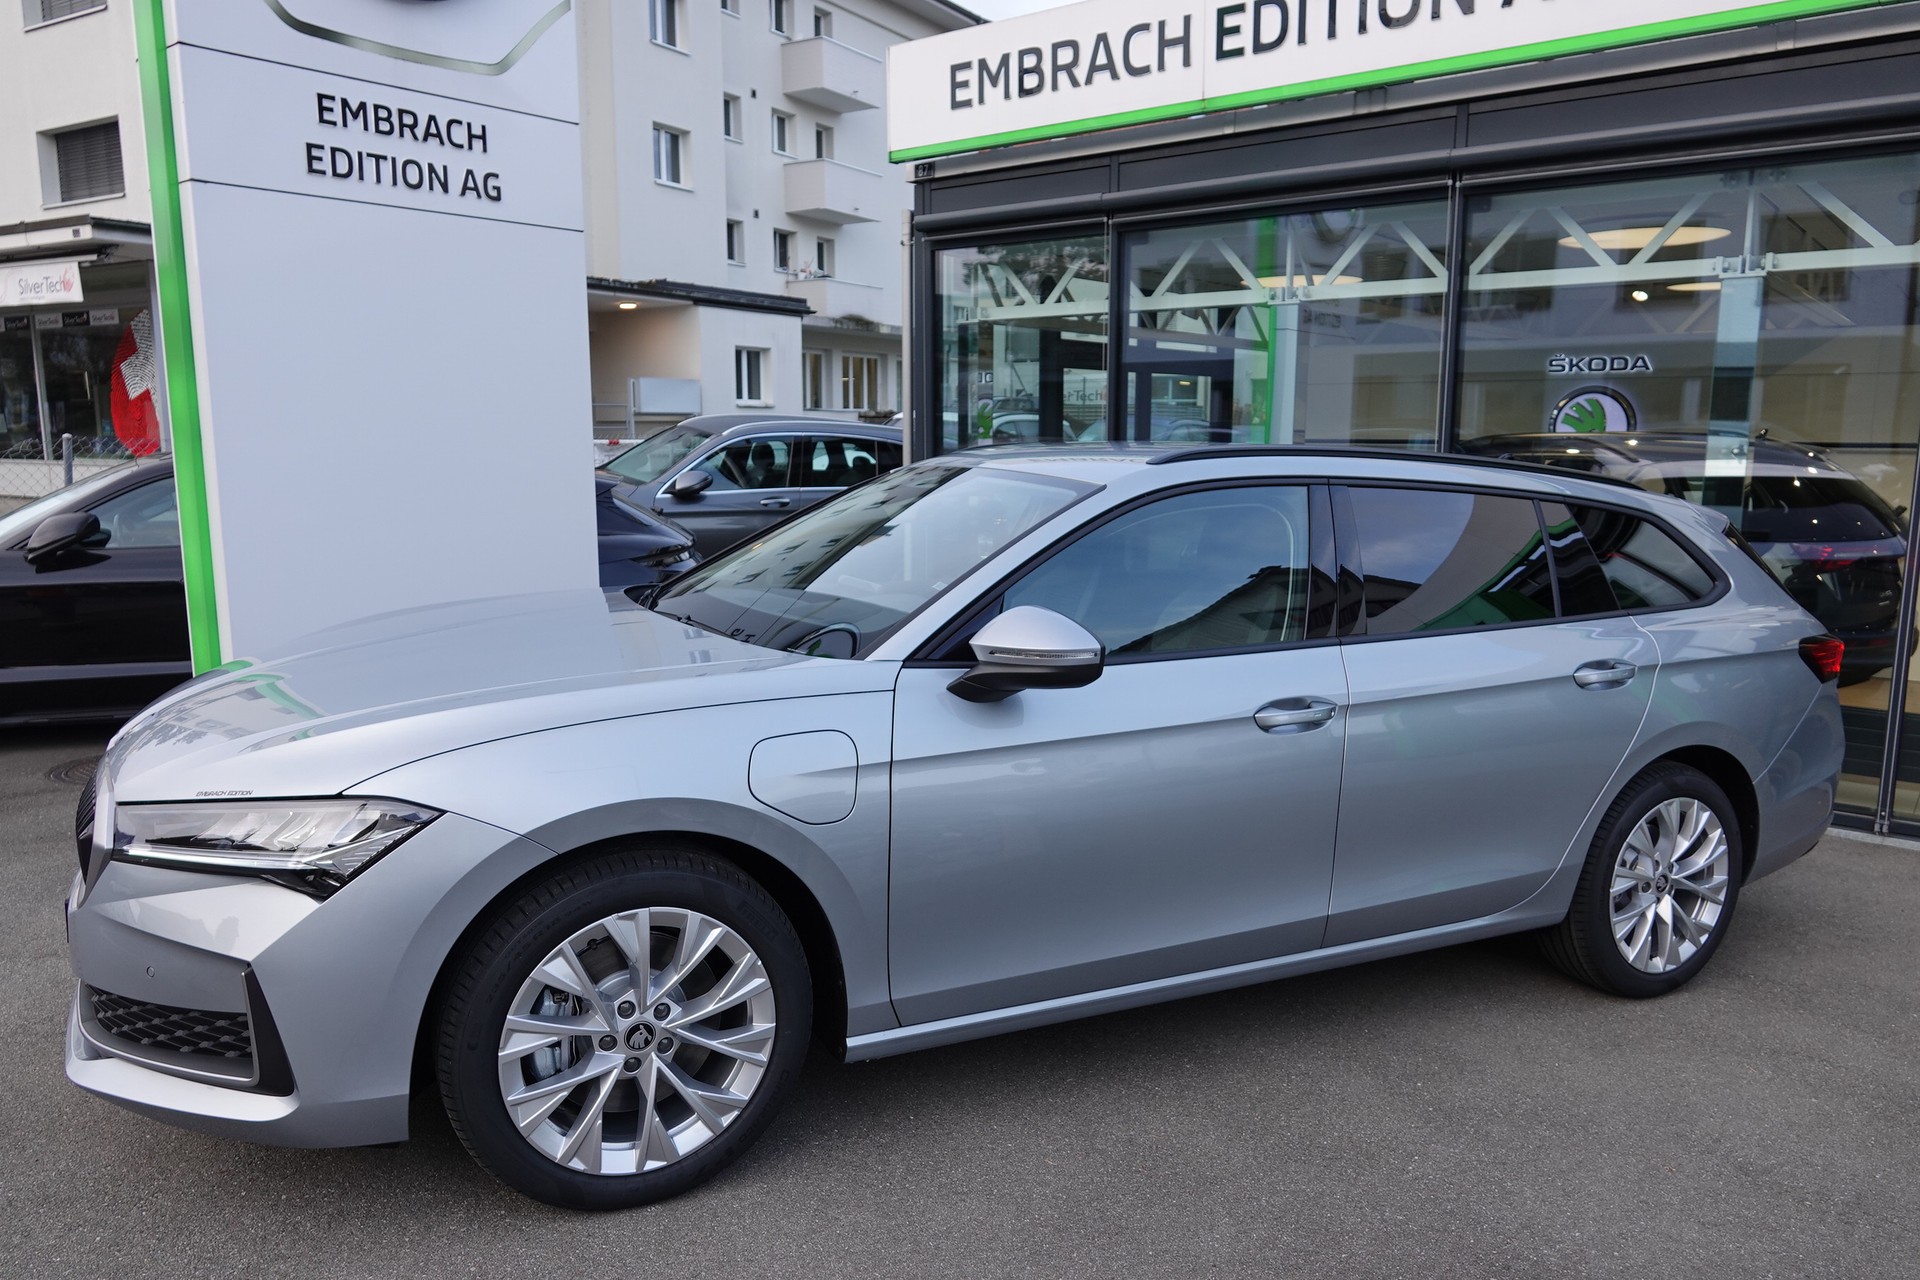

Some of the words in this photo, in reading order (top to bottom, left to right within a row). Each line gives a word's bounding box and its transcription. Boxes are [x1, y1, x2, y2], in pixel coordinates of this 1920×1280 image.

[950, 14, 1192, 110] EMBRACH
[316, 92, 488, 153] EMBRACH
[305, 142, 449, 194] EDITION
[459, 168, 502, 201] AG
[18, 274, 66, 295] SilverTech
[1547, 353, 1651, 373] ŠKODA
